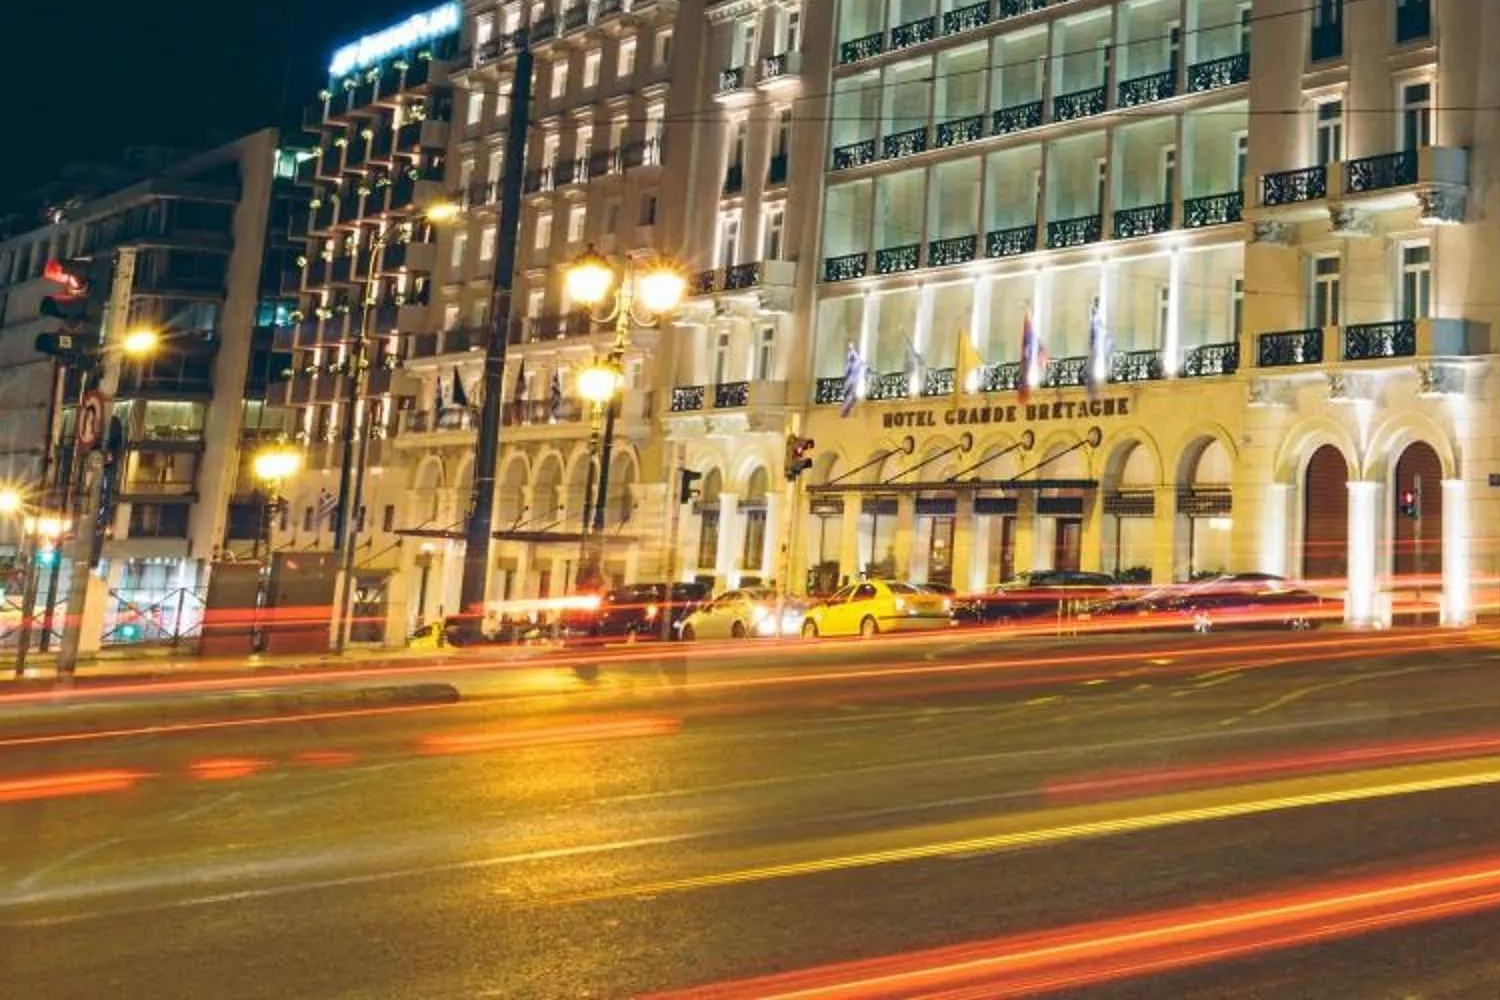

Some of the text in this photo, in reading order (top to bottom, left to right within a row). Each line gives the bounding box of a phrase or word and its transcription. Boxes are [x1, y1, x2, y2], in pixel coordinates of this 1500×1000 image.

[883, 398, 1128, 429] HOTEL GRANDE BRETAGNE
